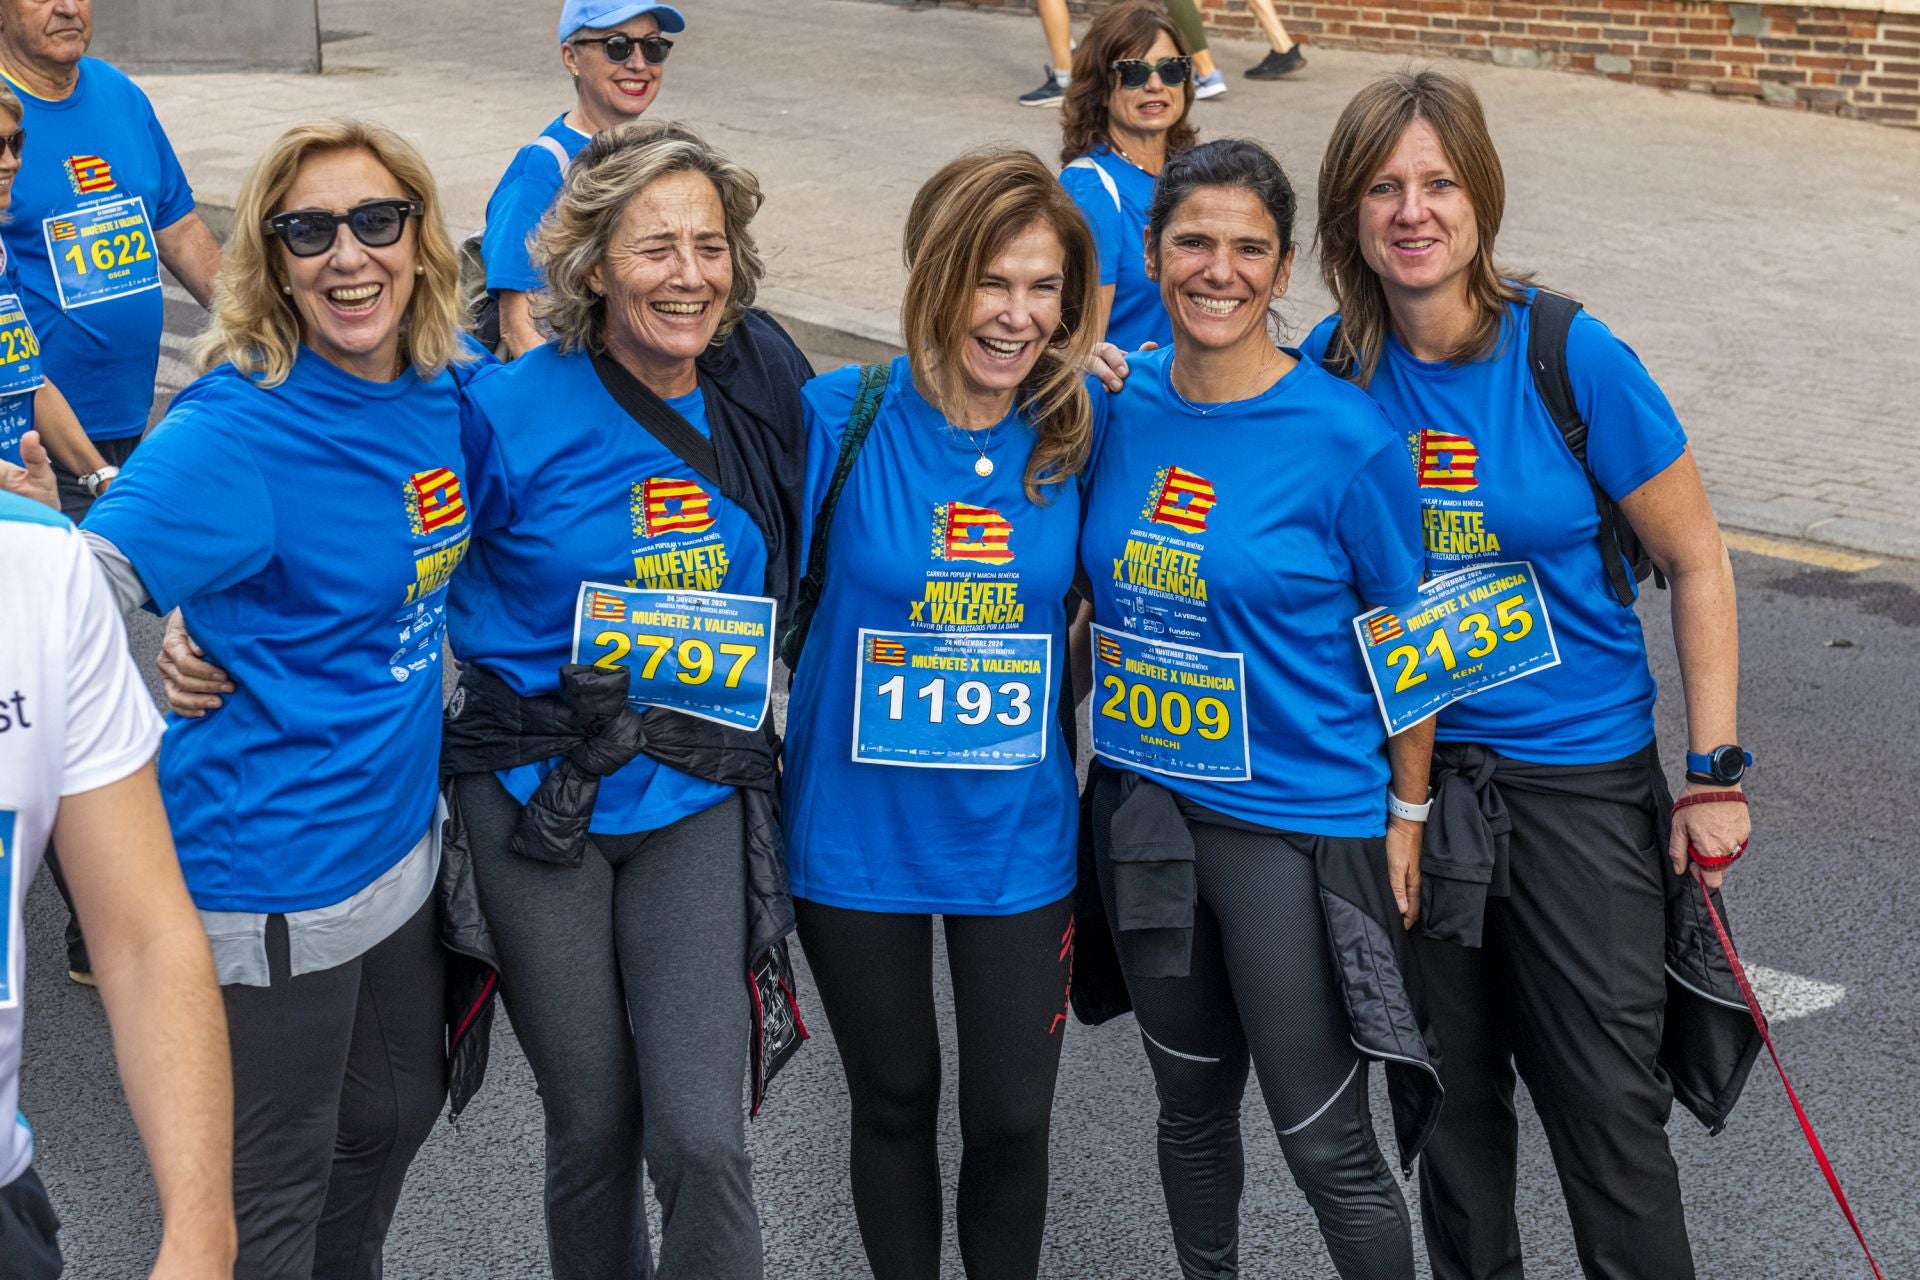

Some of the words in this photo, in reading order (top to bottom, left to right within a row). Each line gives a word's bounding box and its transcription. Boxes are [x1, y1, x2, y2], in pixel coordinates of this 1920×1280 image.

[65, 230, 152, 276] 1622
[108, 269, 130, 280] OSCAR
[0, 326, 40, 366] 238
[1462, 499, 1484, 507] BENÉFICA
[1423, 505, 1485, 533] UÉVETE
[632, 546, 654, 554] CARRERA
[654, 542, 677, 550] POPULAR
[682, 538, 703, 546] MARCHA
[1130, 529, 1148, 538] CARRERA
[1148, 533, 1166, 541] POPULAR
[1170, 538, 1185, 546] MARCHA
[1186, 541, 1204, 551] BENÉFICA
[1423, 530, 1501, 554] LENCIA
[634, 544, 730, 579] MUÉVETE
[1124, 539, 1201, 577] MUÉVETE
[1431, 552, 1460, 560] AFECTADOS
[998, 571, 1019, 579] BENÉFICA
[1113, 558, 1124, 581] X
[1128, 562, 1208, 601] VALENCIA
[1467, 570, 1482, 579] 2024
[403, 582, 417, 604] X
[925, 578, 1018, 604] MUÉVETE
[1119, 582, 1132, 591] FAVOR
[1148, 589, 1174, 601] AFECTADOS
[909, 601, 925, 621] X
[931, 603, 1024, 624] VALENCIA
[1406, 598, 1459, 632] MUÉVETE
[1458, 594, 1470, 608] X
[1468, 574, 1527, 603] VALENCIA
[632, 608, 690, 629] MUÉVETE
[692, 616, 702, 630] X
[705, 618, 764, 637] VALENCIA
[916, 622, 936, 630] FAVOR
[956, 624, 986, 632] AFECTADOS
[1182, 613, 1207, 622] VERDAD
[1169, 627, 1200, 637] fundown
[1155, 648, 1185, 659] NOVIEMBRE
[1185, 653, 1198, 661] 2024
[1386, 593, 1534, 694] 2135
[593, 630, 758, 689] 2797
[912, 654, 967, 671] MUÉVETE
[971, 659, 979, 672] X
[982, 659, 1040, 674] VALENCIA
[1125, 658, 1168, 681] MUÉVETE
[1170, 670, 1178, 683] X
[1180, 671, 1235, 691] VALENCIA
[1452, 663, 1484, 680] KENY
[878, 675, 1032, 726] 1193
[1101, 674, 1231, 740] 2009
[1140, 734, 1180, 750] MANCHI
